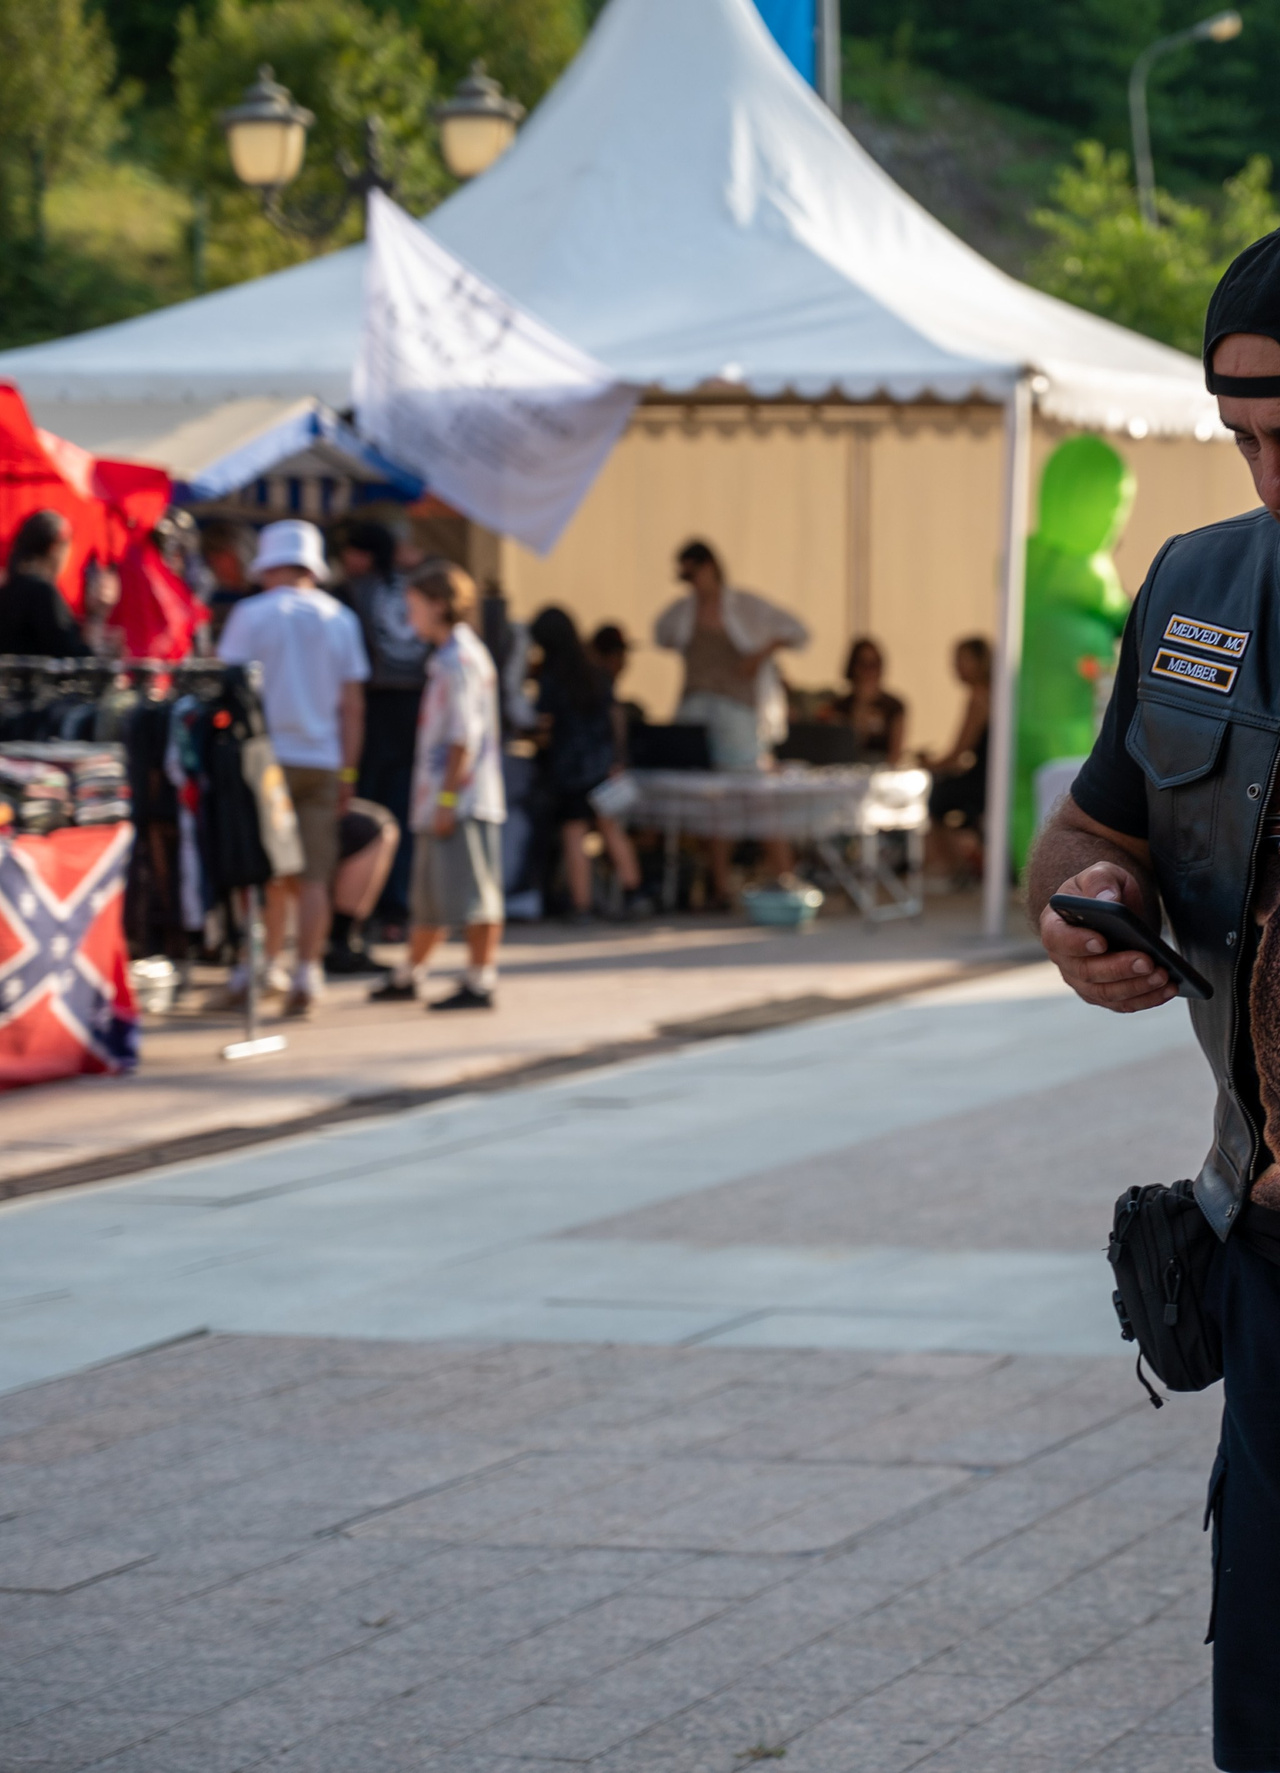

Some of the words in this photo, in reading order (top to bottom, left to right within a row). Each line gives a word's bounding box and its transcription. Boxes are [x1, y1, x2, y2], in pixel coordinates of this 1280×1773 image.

[1169, 621, 1222, 645] MEDVEDI
[1223, 636, 1244, 652] MC
[1167, 657, 1218, 682] MEMBER
